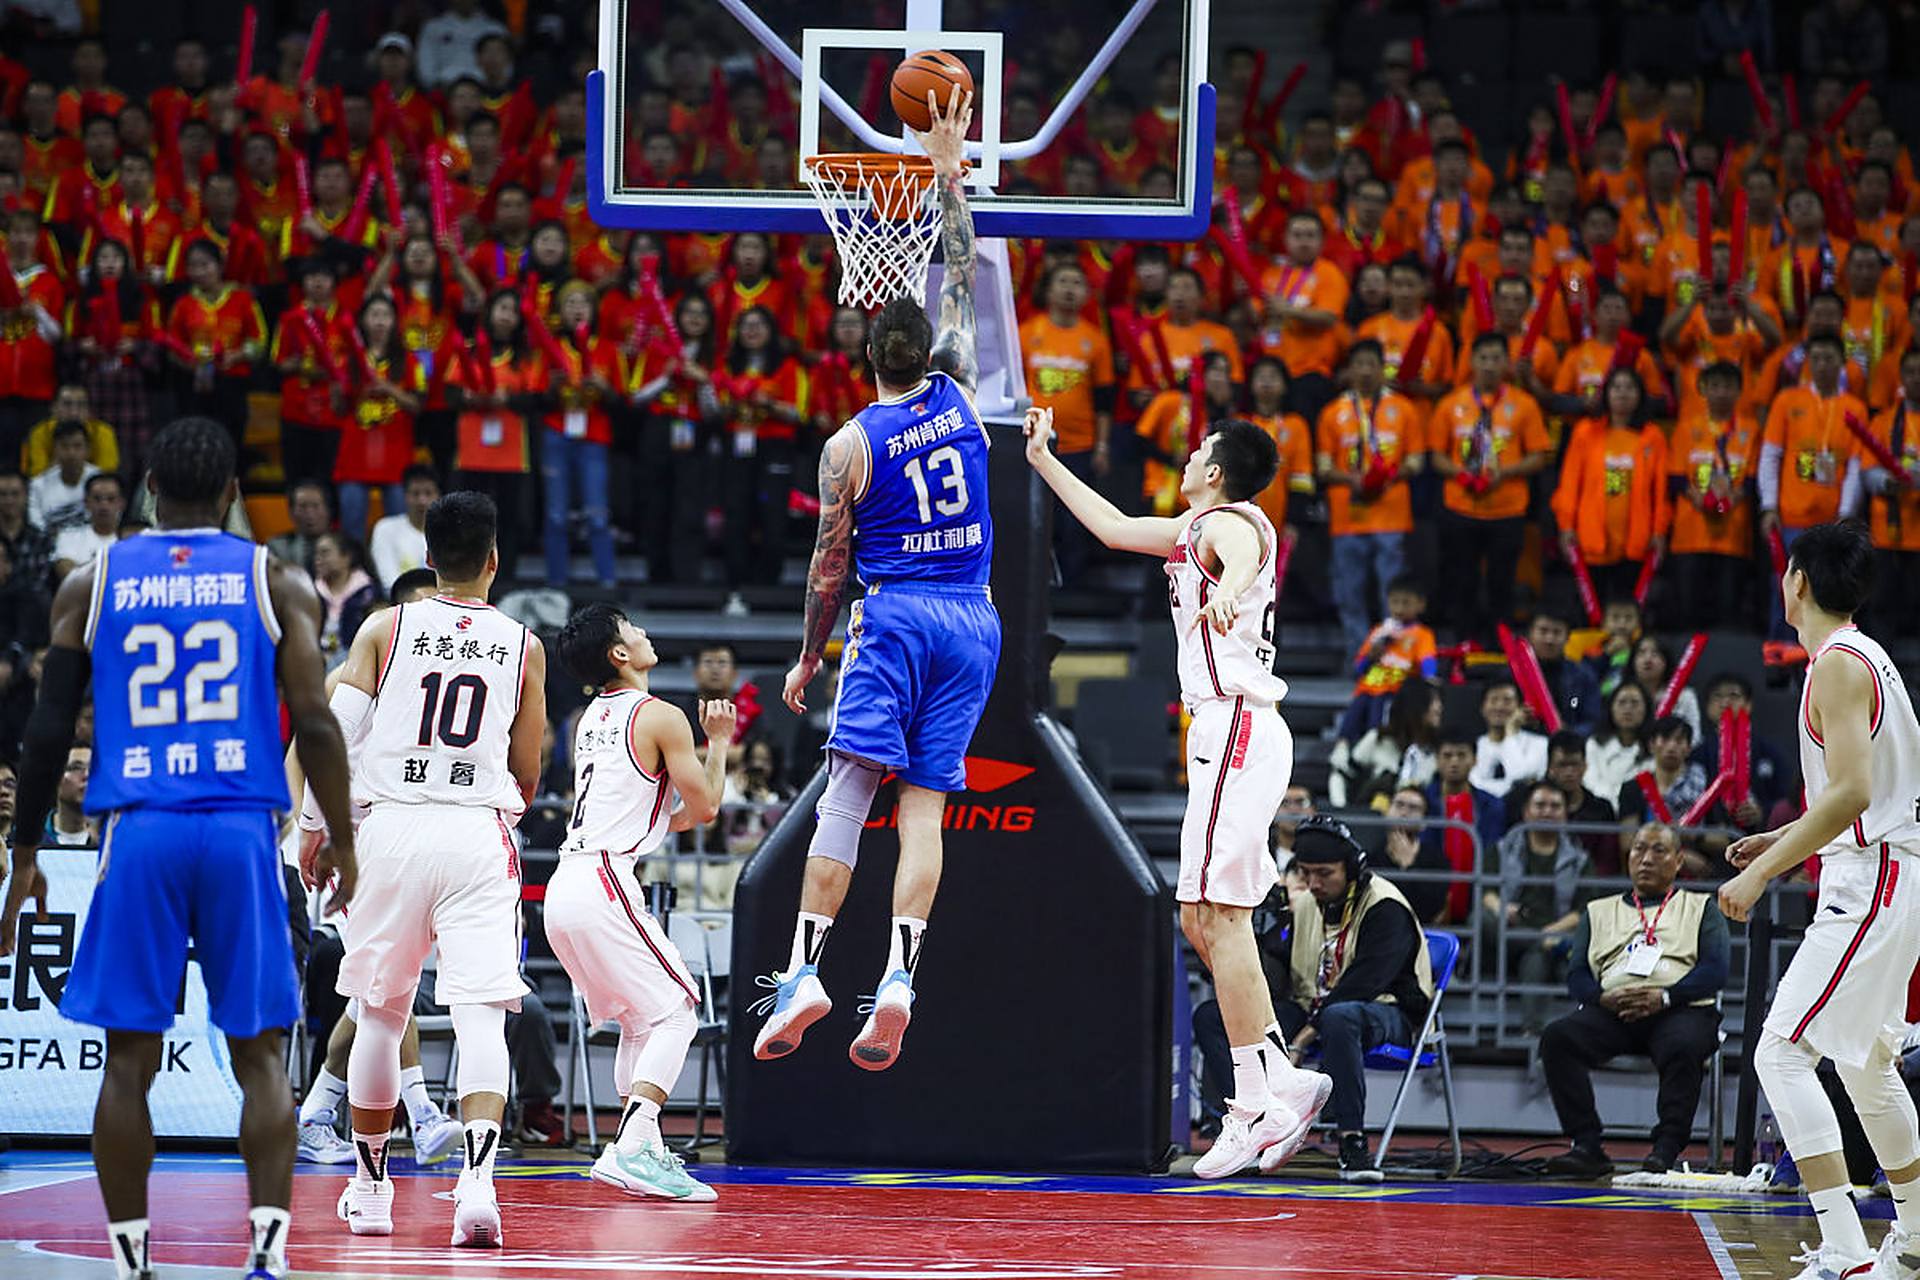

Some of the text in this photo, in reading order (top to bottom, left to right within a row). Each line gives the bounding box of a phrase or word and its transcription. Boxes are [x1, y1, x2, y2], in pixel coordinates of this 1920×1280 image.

[885, 406, 965, 459] 苏州肯帝亚
[903, 445, 970, 525] 13
[112, 572, 247, 613] 苏州肯帝亚
[122, 619, 239, 728] 22
[411, 631, 510, 667] 东莞银行
[417, 671, 489, 750] 10
[79, 1039, 193, 1073] BK
